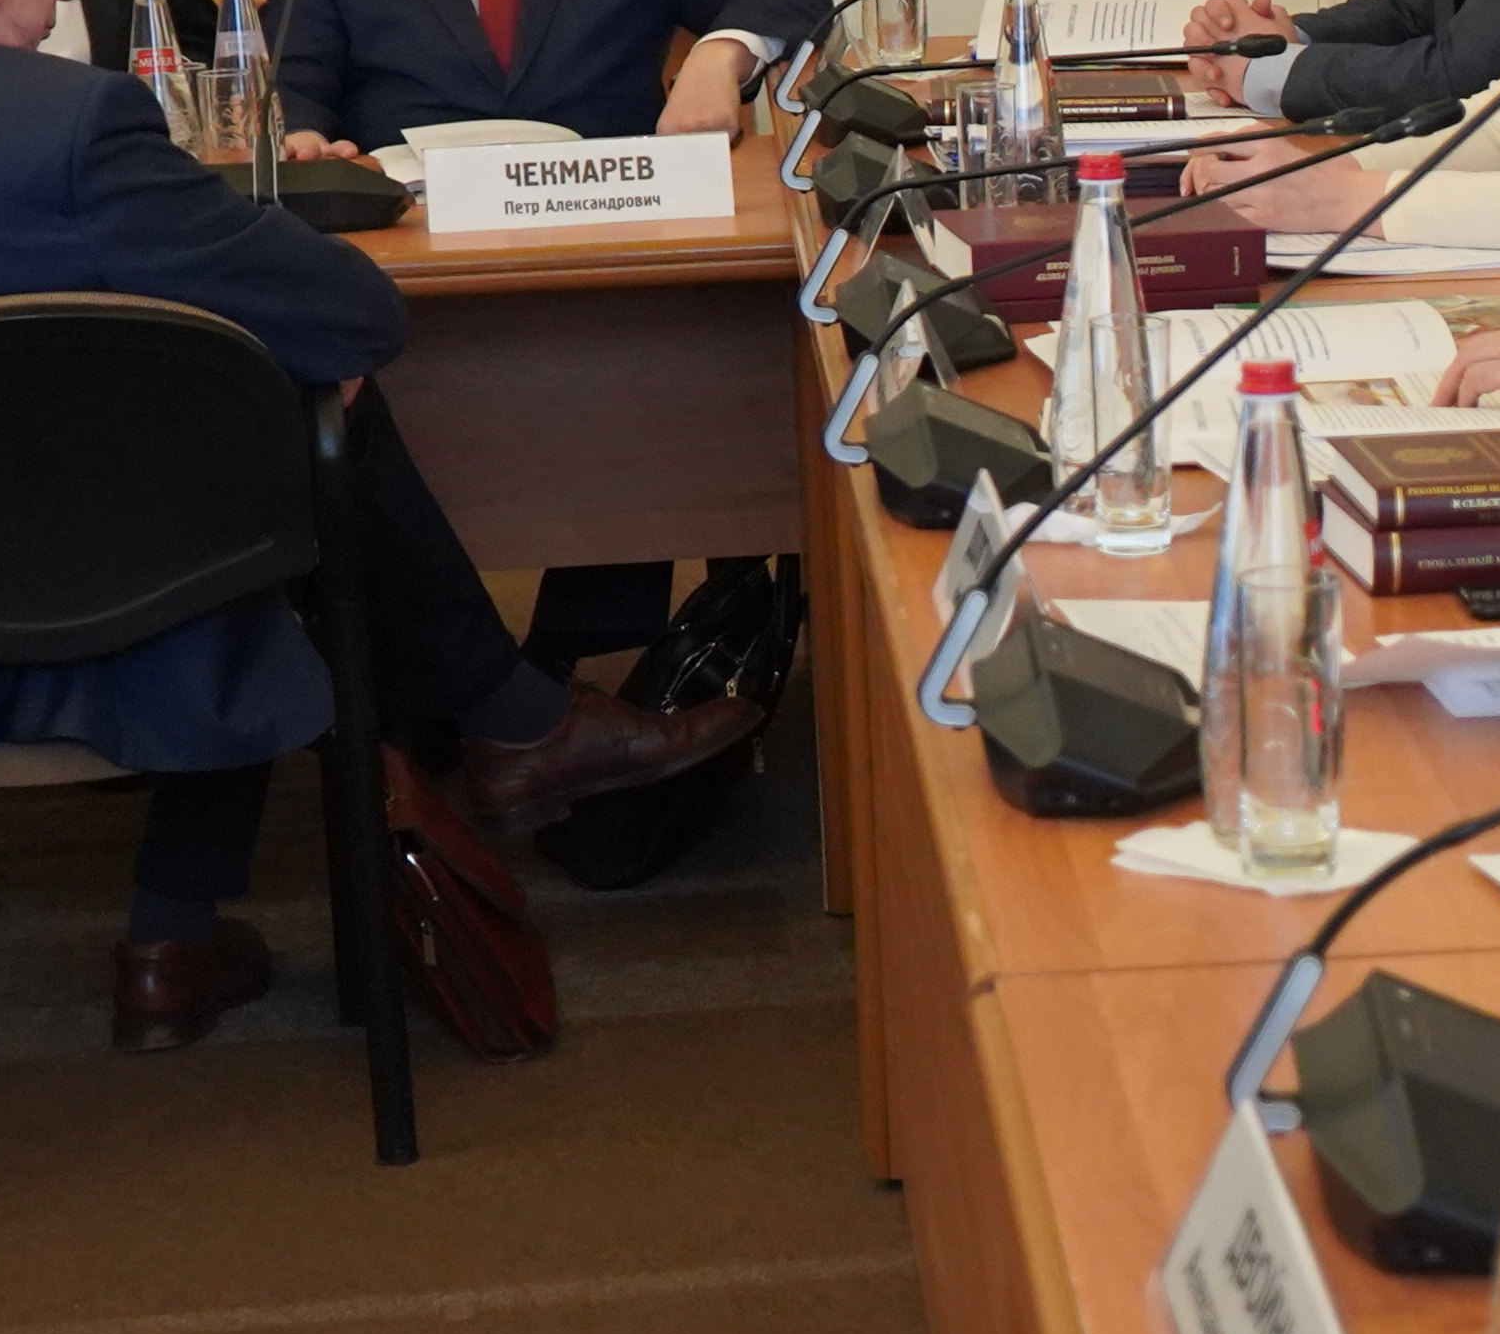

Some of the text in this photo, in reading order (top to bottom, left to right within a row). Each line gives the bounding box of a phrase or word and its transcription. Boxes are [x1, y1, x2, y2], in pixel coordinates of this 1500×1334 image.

[504, 155, 655, 187] ЧЕКМАРЕВ
[504, 195, 661, 216] Петр Александрович
